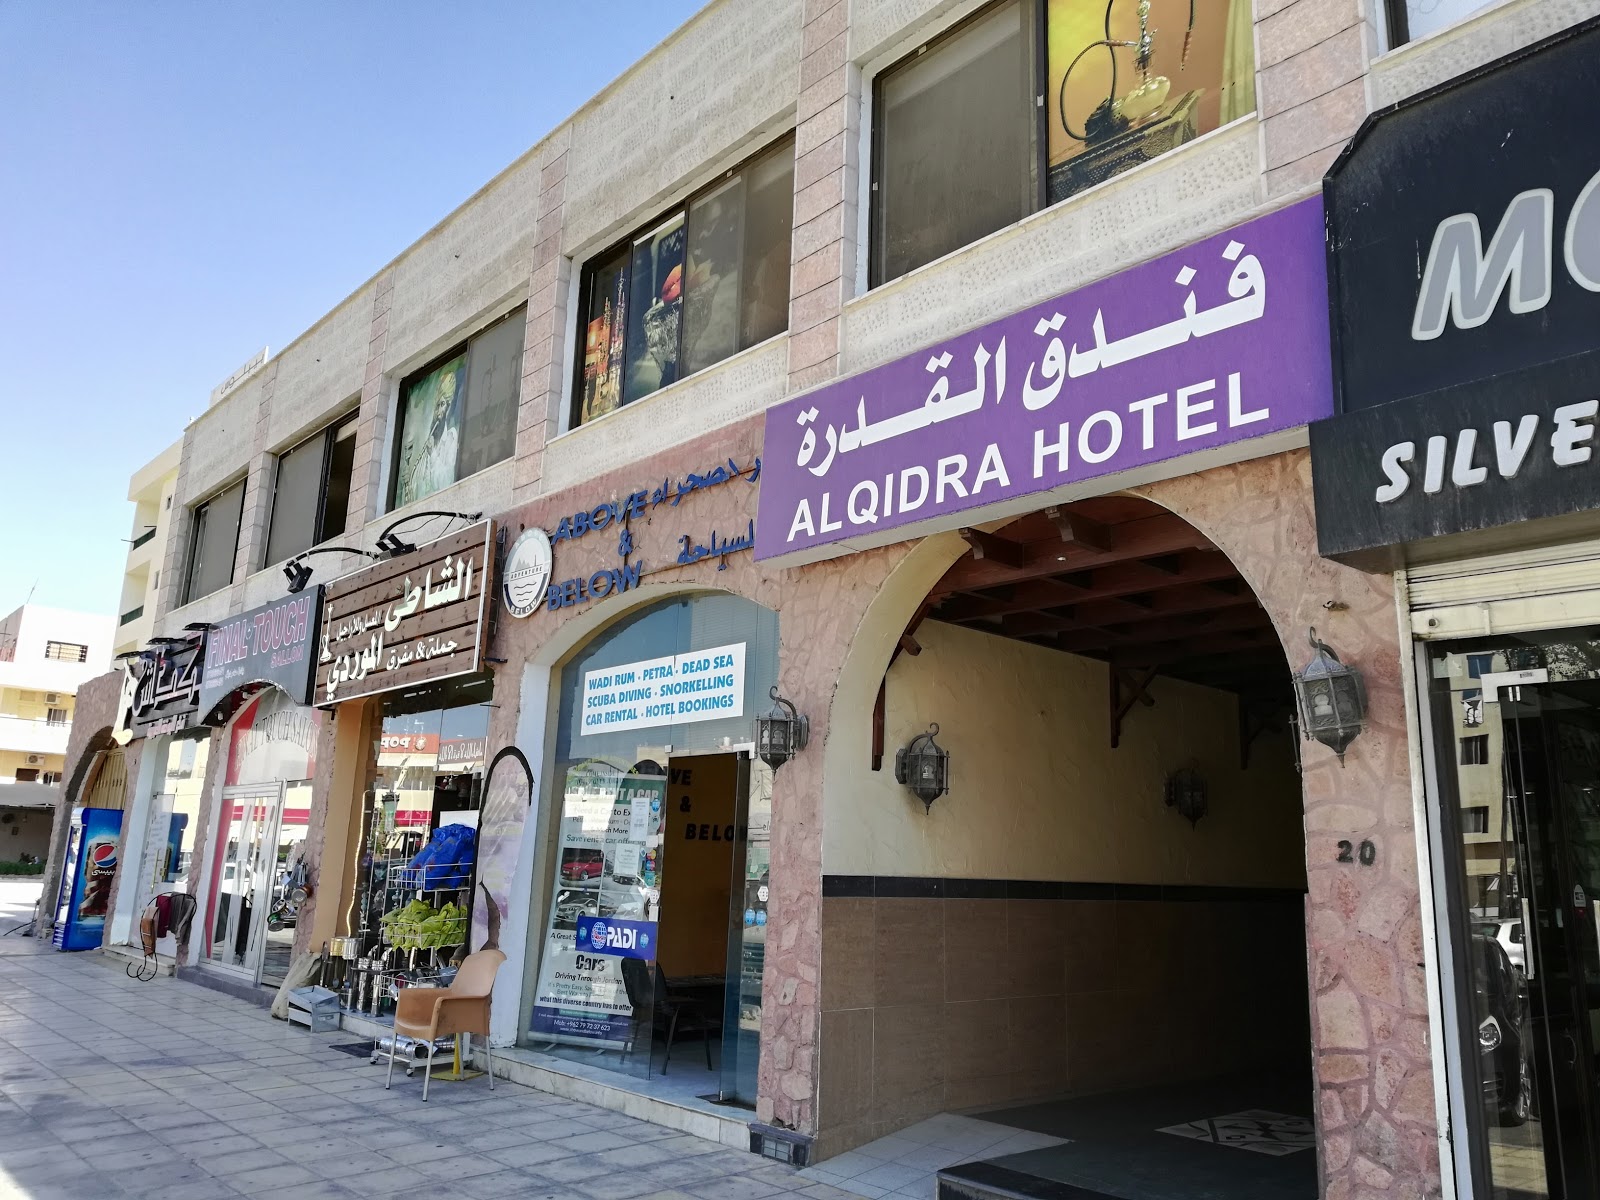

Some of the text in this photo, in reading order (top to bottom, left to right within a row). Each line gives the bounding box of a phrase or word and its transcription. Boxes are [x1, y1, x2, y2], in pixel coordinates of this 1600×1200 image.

[797, 239, 1266, 477] فندق القدرة
[1033, 371, 1270, 479] HOTEL
[1376, 399, 1600, 503] SILVE
[551, 490, 648, 545] ABOVE
[618, 529, 633, 557] &
[511, 565, 543, 580] ADVENTURE
[547, 560, 642, 611] BELOW
[510, 599, 538, 615] BELOW
[207, 596, 311, 669] FINAL TOUCH
[588, 654, 734, 690] WADI RUM PETRA DEAD SEA
[587, 674, 734, 708] SCUBA DIVING SNORKELLING
[585, 694, 734, 726] CAR RENTAL HOTEL BOOKINGS
[260, 711, 293, 744] TOUCH
[1336, 839, 1376, 867] 20
[606, 926, 638, 950] PADI
[555, 971, 577, 981] Driving
[575, 954, 606, 972] Cars
